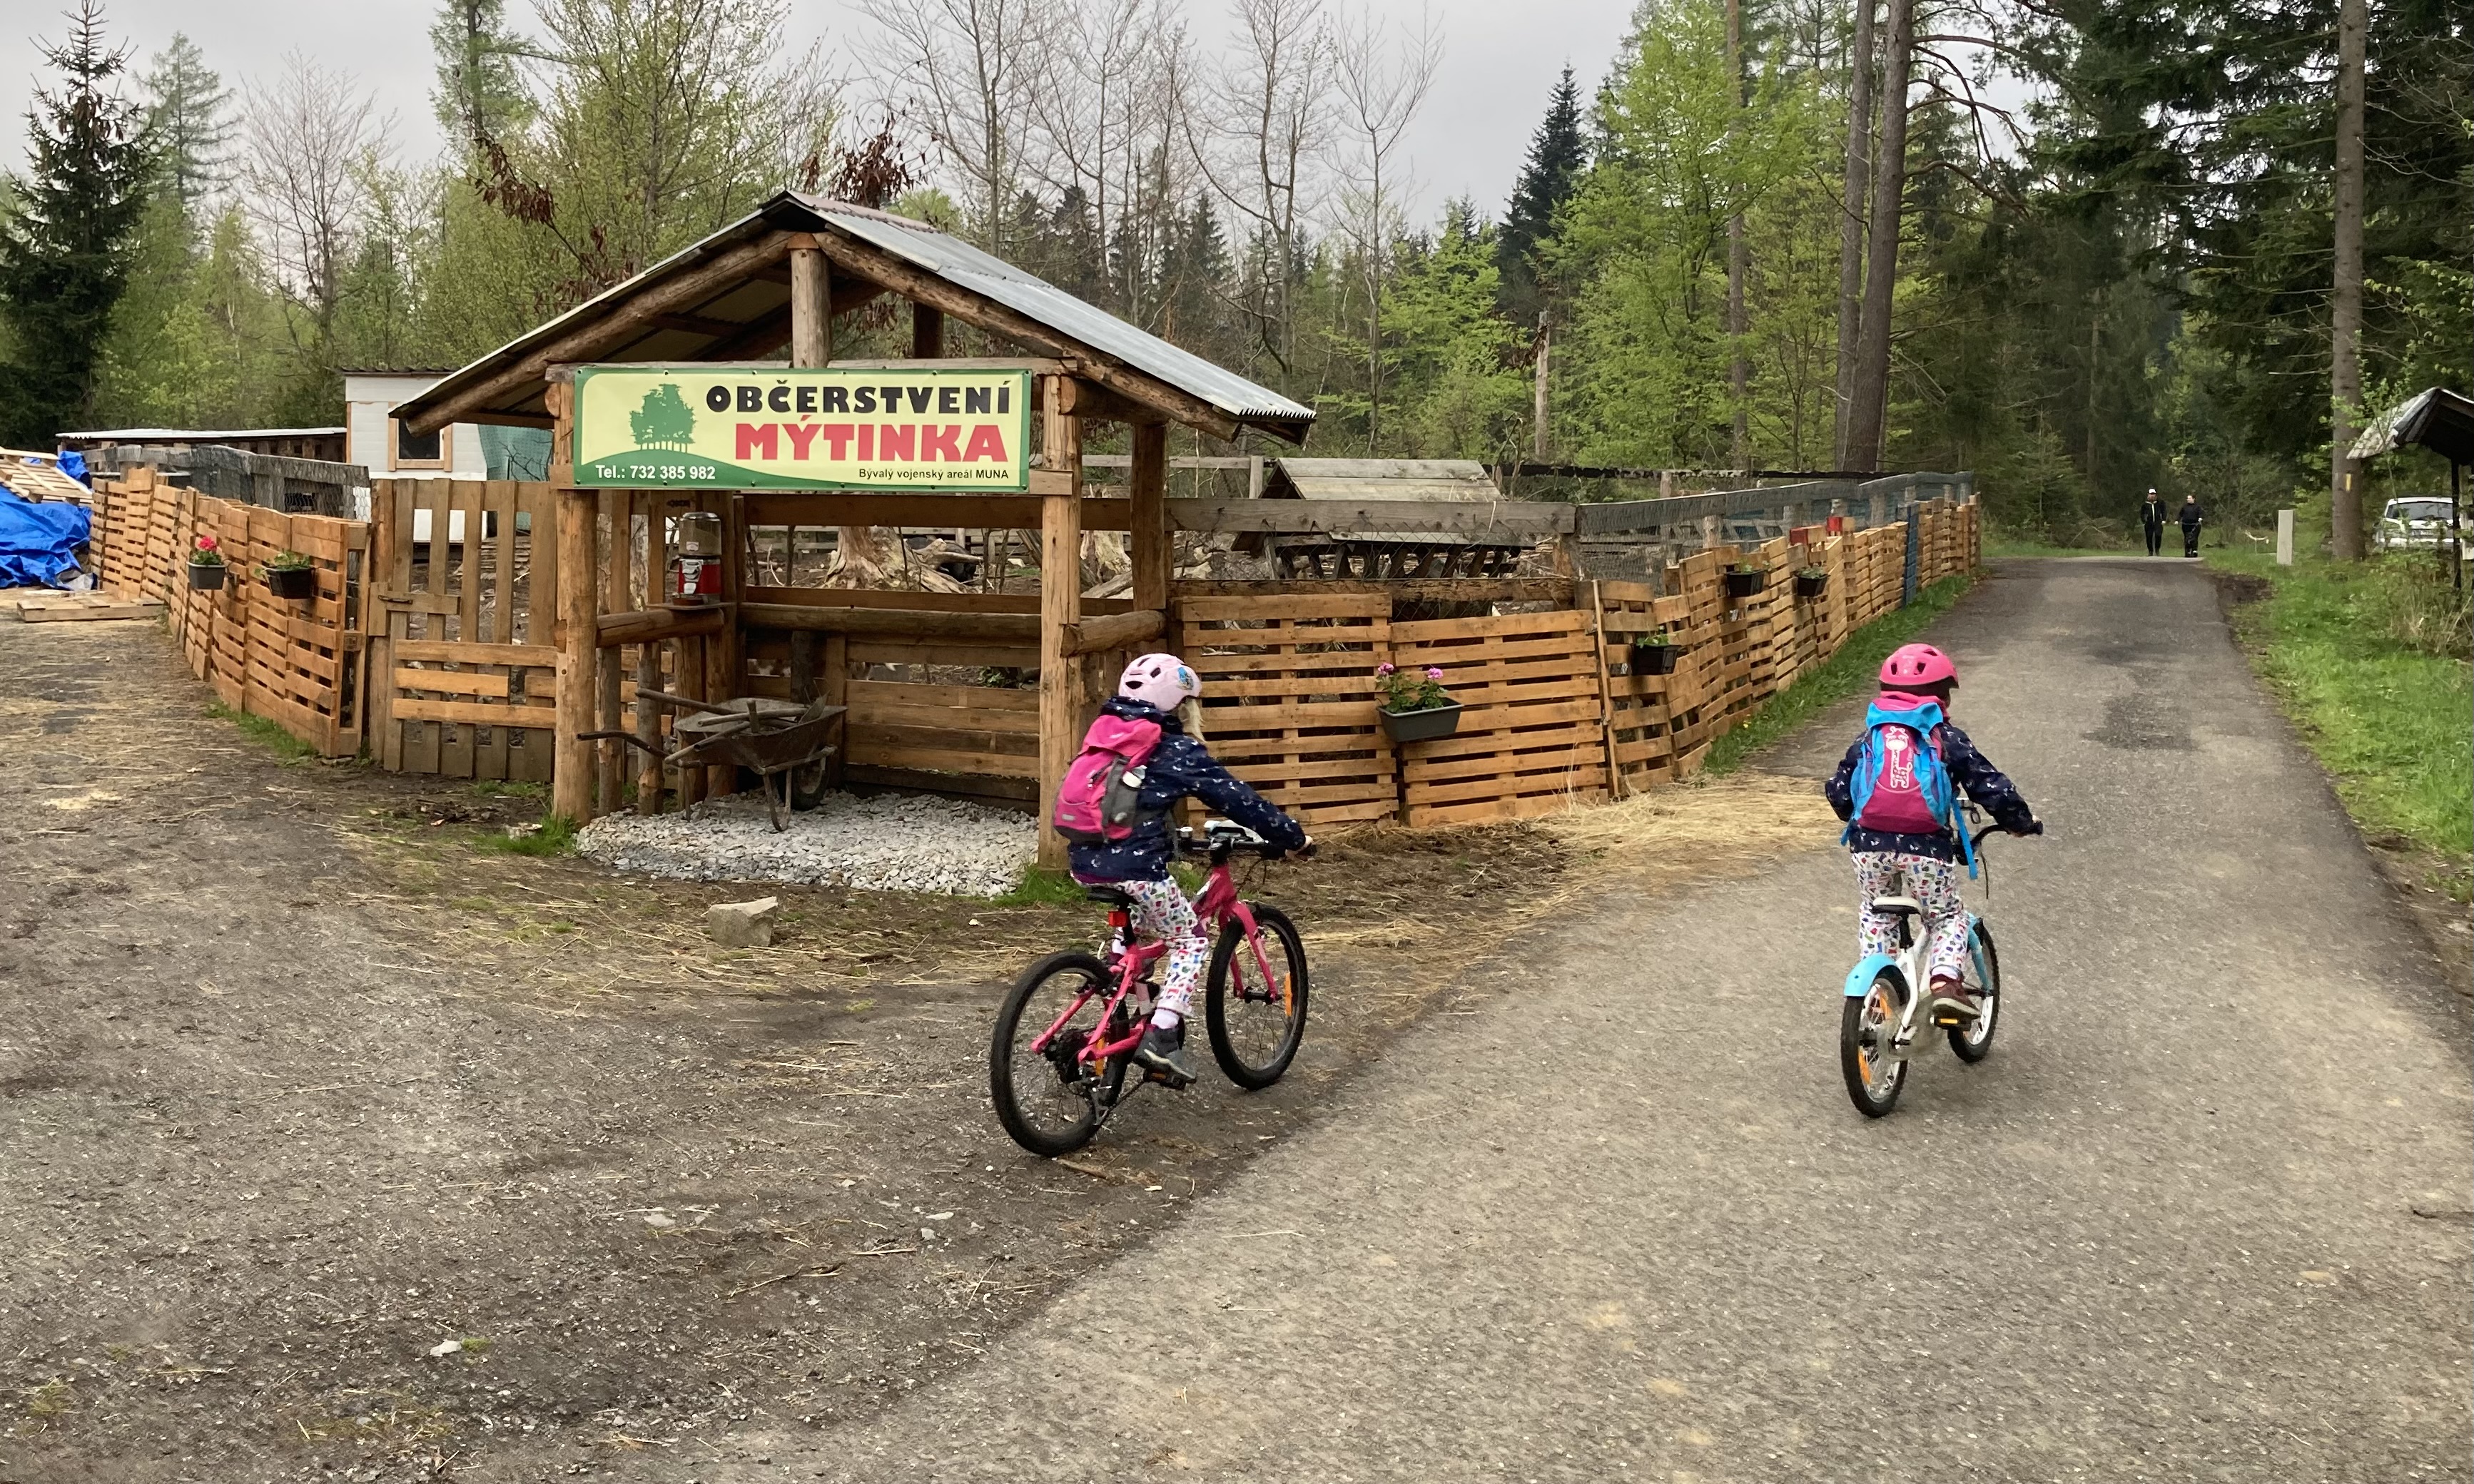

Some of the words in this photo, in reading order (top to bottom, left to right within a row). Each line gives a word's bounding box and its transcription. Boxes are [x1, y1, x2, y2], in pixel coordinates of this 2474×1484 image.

[706, 379, 1010, 414] OBČERSTVENÍ
[735, 415, 1008, 462] MÝTINKA
[595, 465, 625, 479] Tel.:
[630, 465, 656, 479] 732
[659, 466, 686, 479] 385
[689, 466, 716, 479] 982
[859, 468, 893, 479] Bývalý
[897, 468, 943, 481] vojenský
[947, 469, 973, 479] areál
[975, 469, 1009, 479] MUNA
